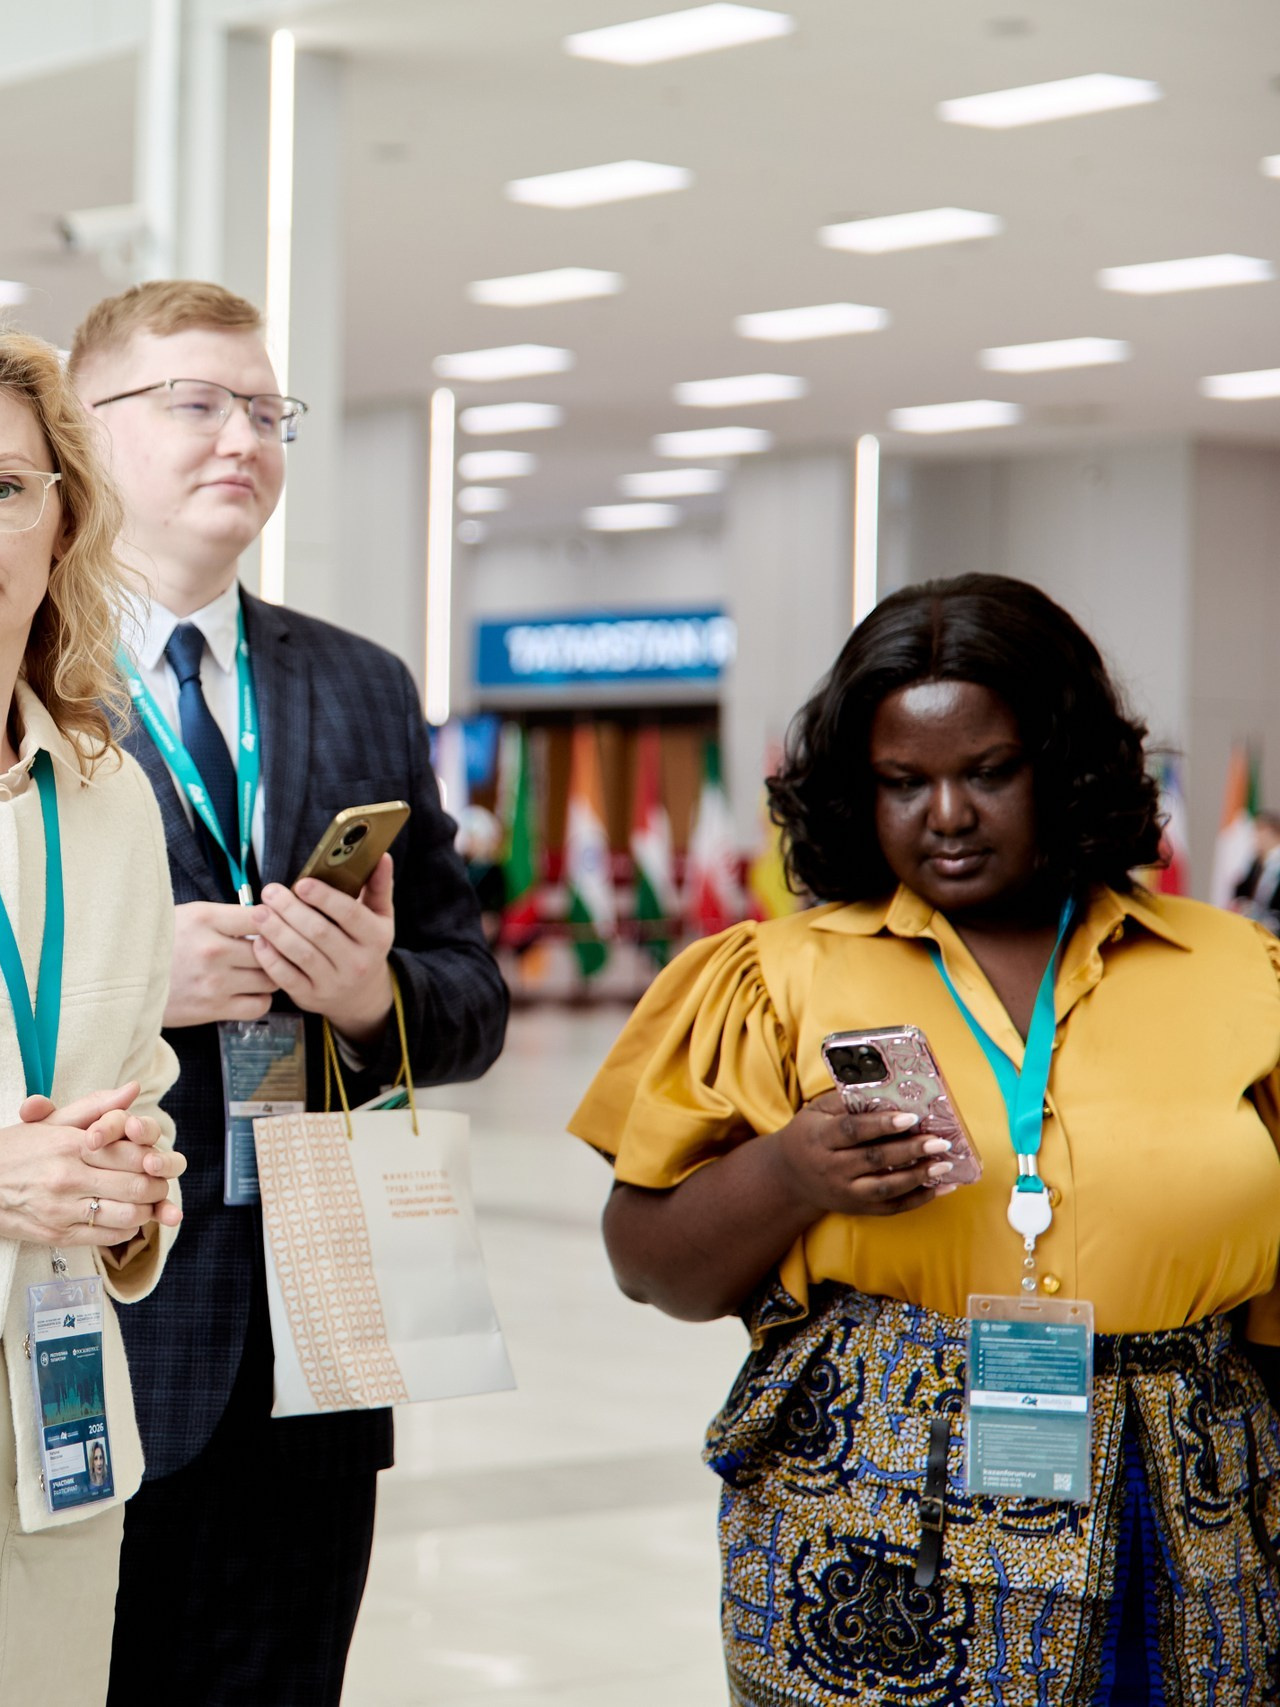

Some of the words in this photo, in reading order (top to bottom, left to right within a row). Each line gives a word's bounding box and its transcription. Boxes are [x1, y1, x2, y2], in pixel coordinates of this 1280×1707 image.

[88, 1423, 104, 1434] 2026
[983, 1469, 1036, 1478] kazanforum.ru
[53, 1478, 75, 1488] УЧАСТНИК
[53, 1485, 78, 1496] PARTICIPANT
